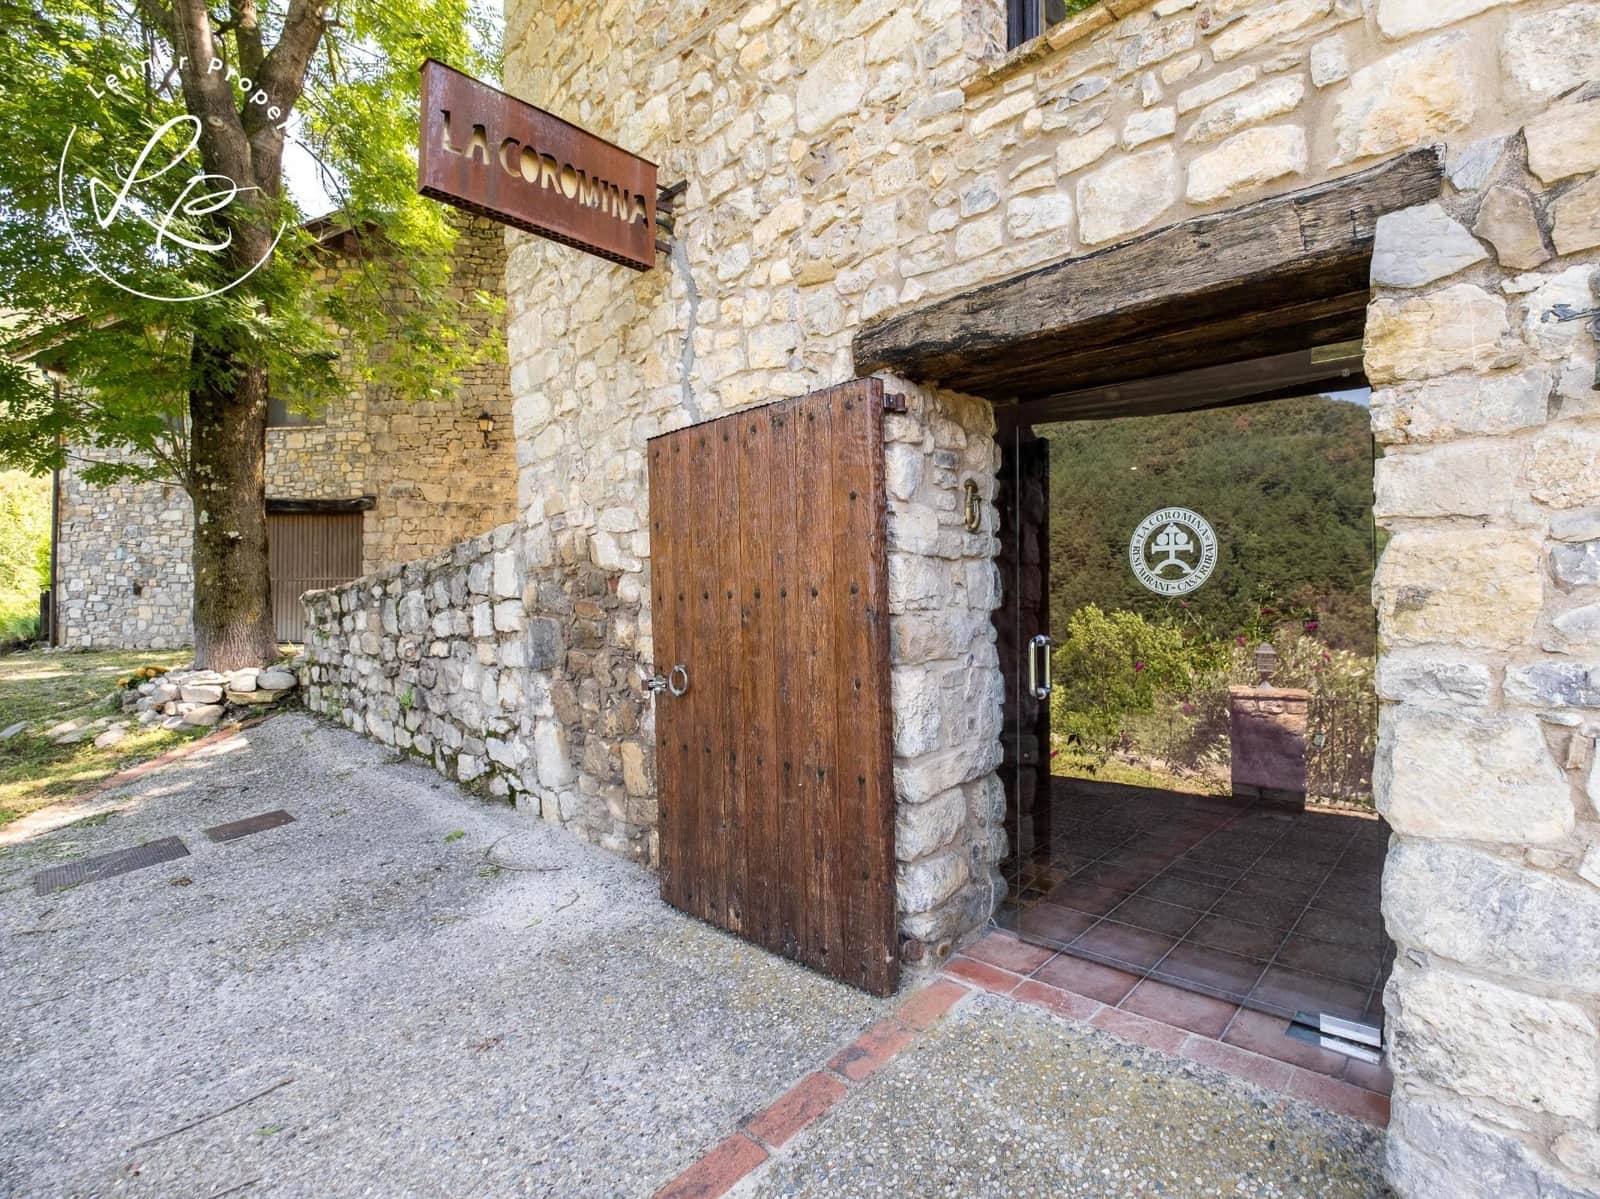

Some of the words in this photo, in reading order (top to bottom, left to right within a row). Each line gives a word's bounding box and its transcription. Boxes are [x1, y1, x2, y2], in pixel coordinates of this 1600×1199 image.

[440, 109, 490, 165] LA
[499, 137, 649, 228] COROMINA
[1137, 525, 1150, 539] LA
[1149, 511, 1208, 537] COROMINA
